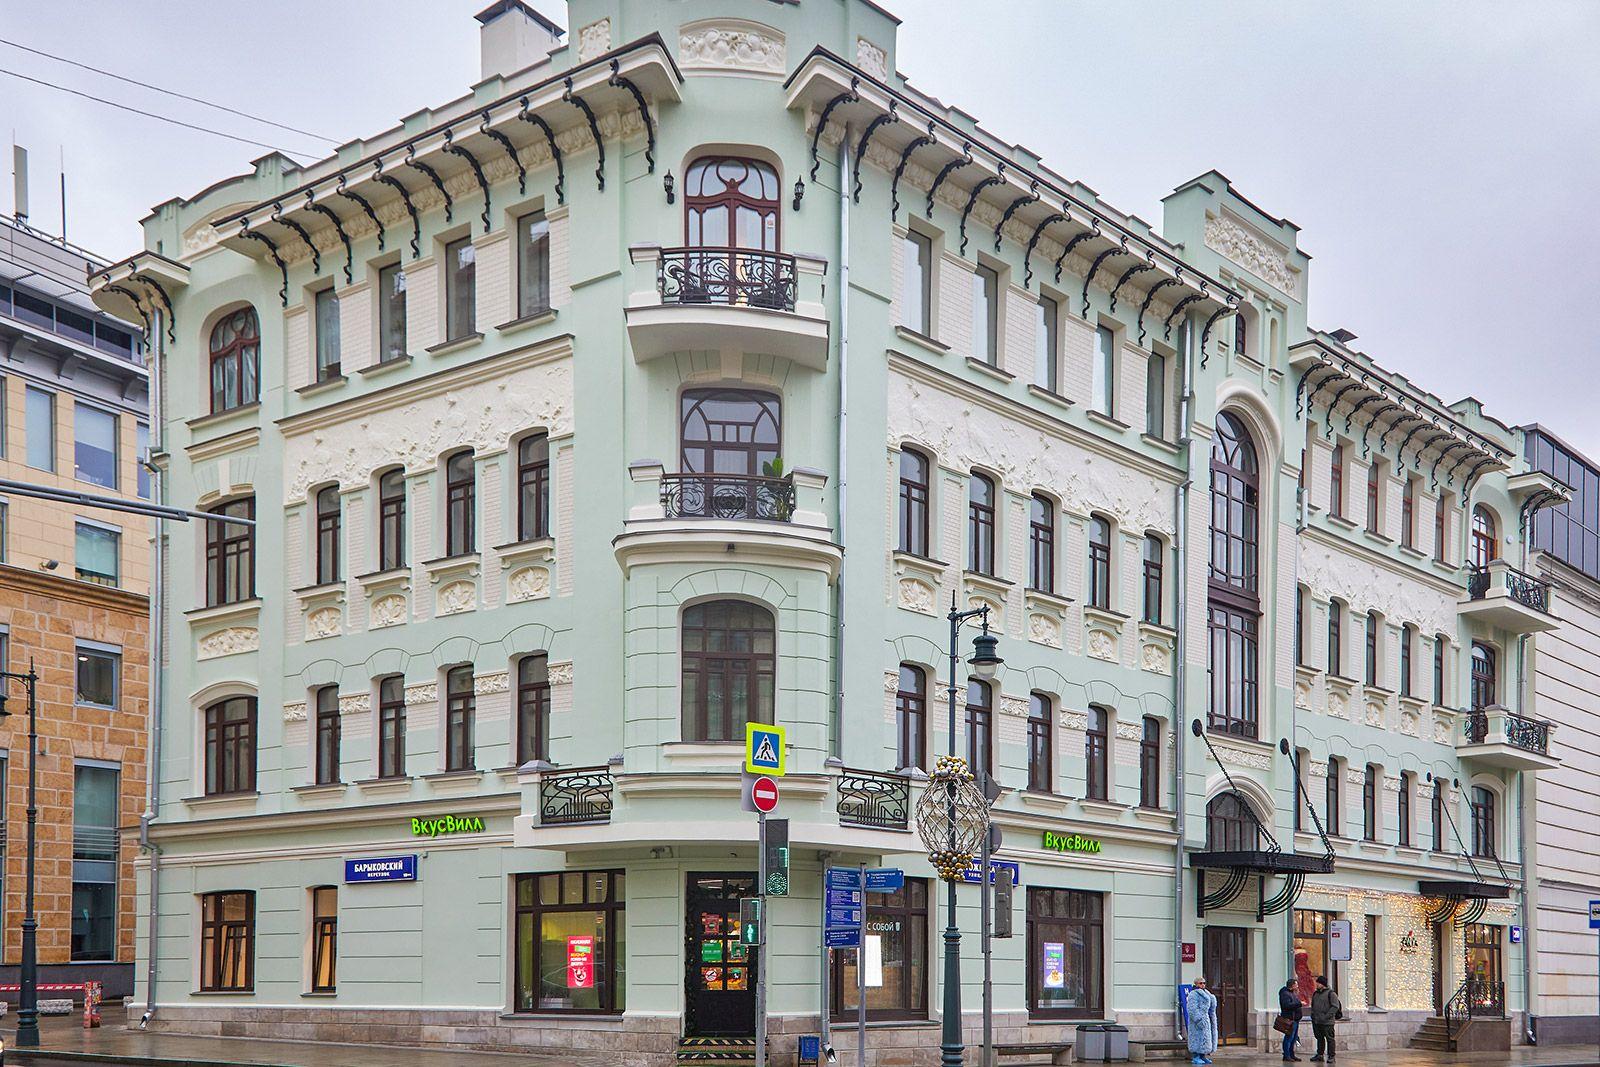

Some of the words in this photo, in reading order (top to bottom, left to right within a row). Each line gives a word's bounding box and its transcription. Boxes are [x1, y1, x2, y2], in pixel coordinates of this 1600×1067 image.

[411, 815, 483, 838] ВкусВилл
[1045, 831, 1101, 852] ВкусВилл
[354, 860, 403, 873] БАРЫКОВСКИЙ
[872, 921, 894, 931] СОБОЙ
